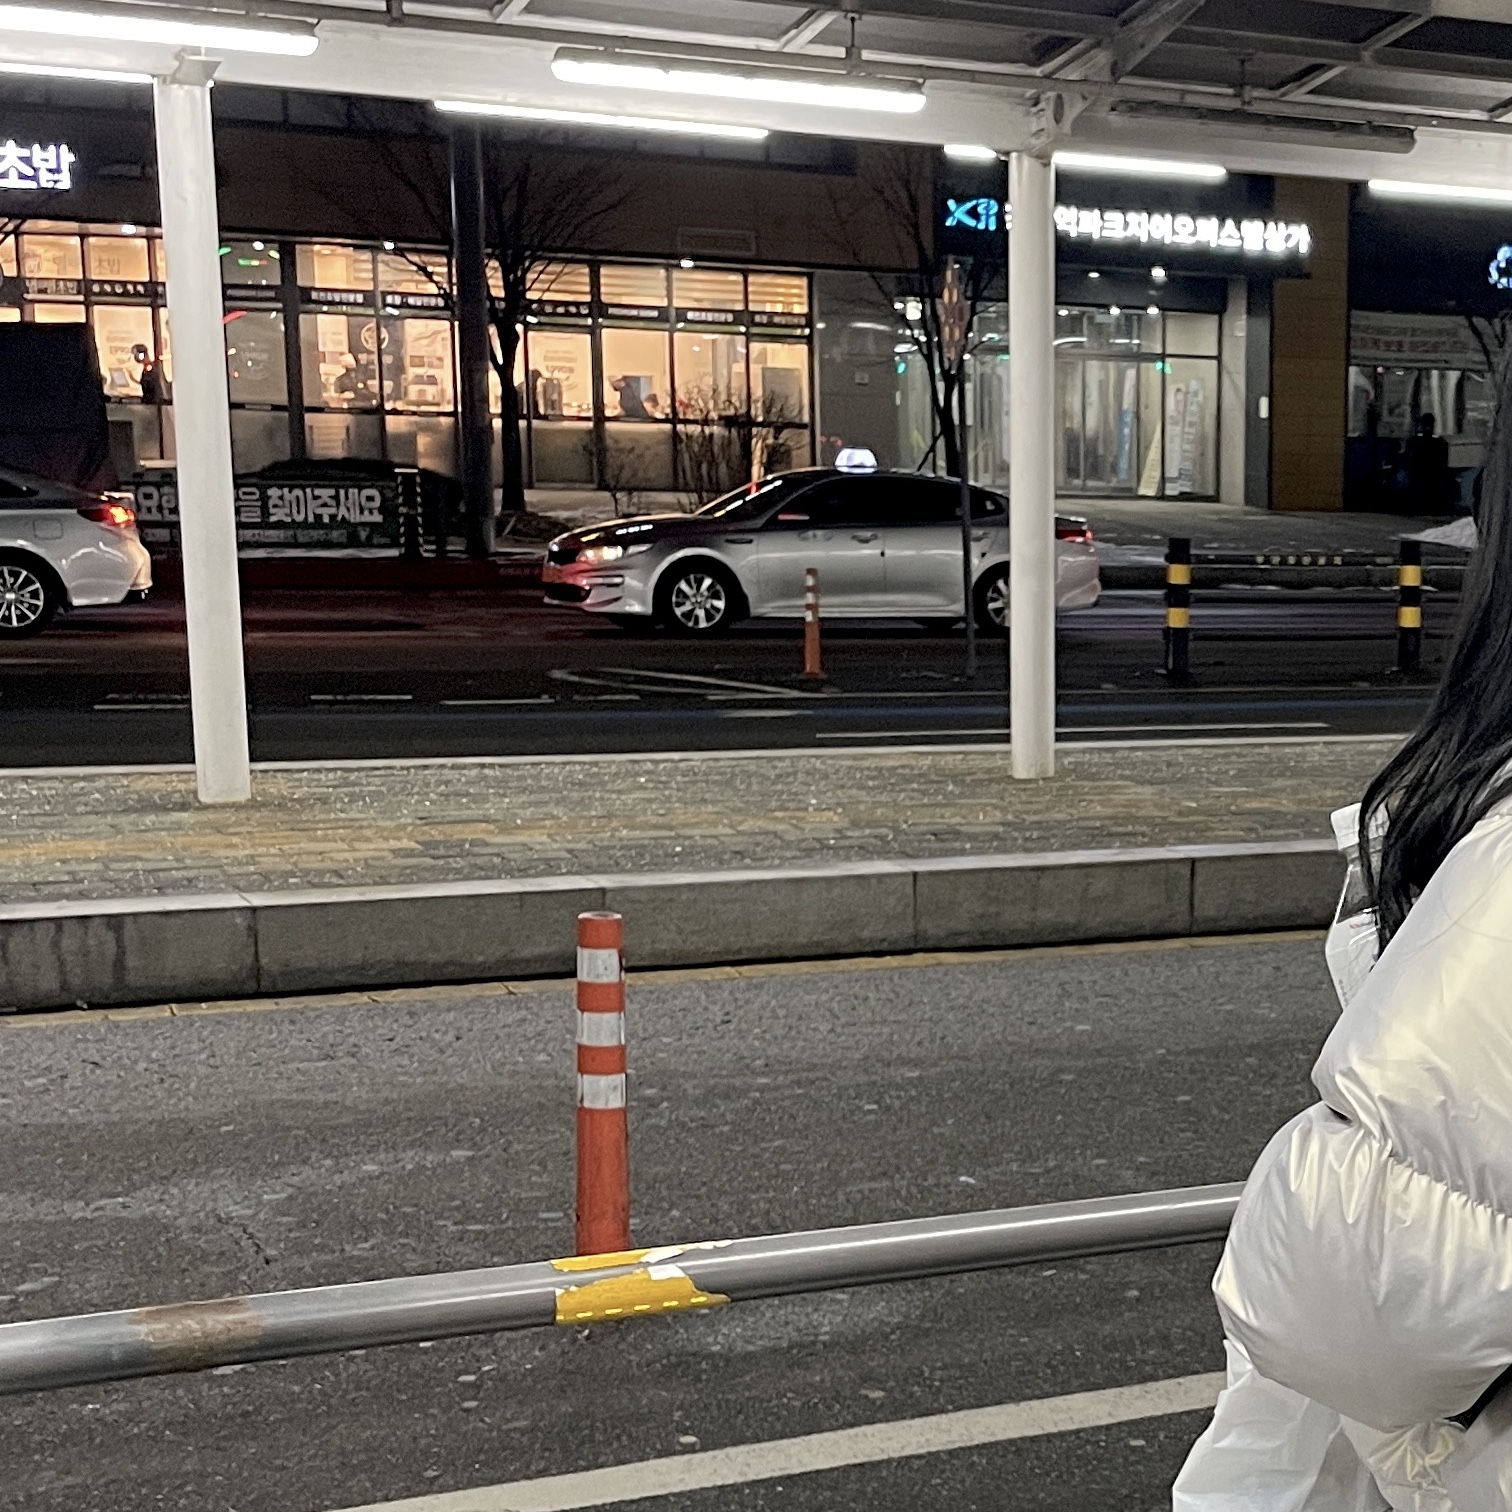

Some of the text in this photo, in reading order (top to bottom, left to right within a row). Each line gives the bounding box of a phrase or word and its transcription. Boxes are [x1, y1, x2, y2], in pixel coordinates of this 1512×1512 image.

[0, 139, 76, 189] 초밥
[1003, 202, 1310, 255] 역파크자이오피스텔상가
[267, 487, 384, 523] 찾아주세요
